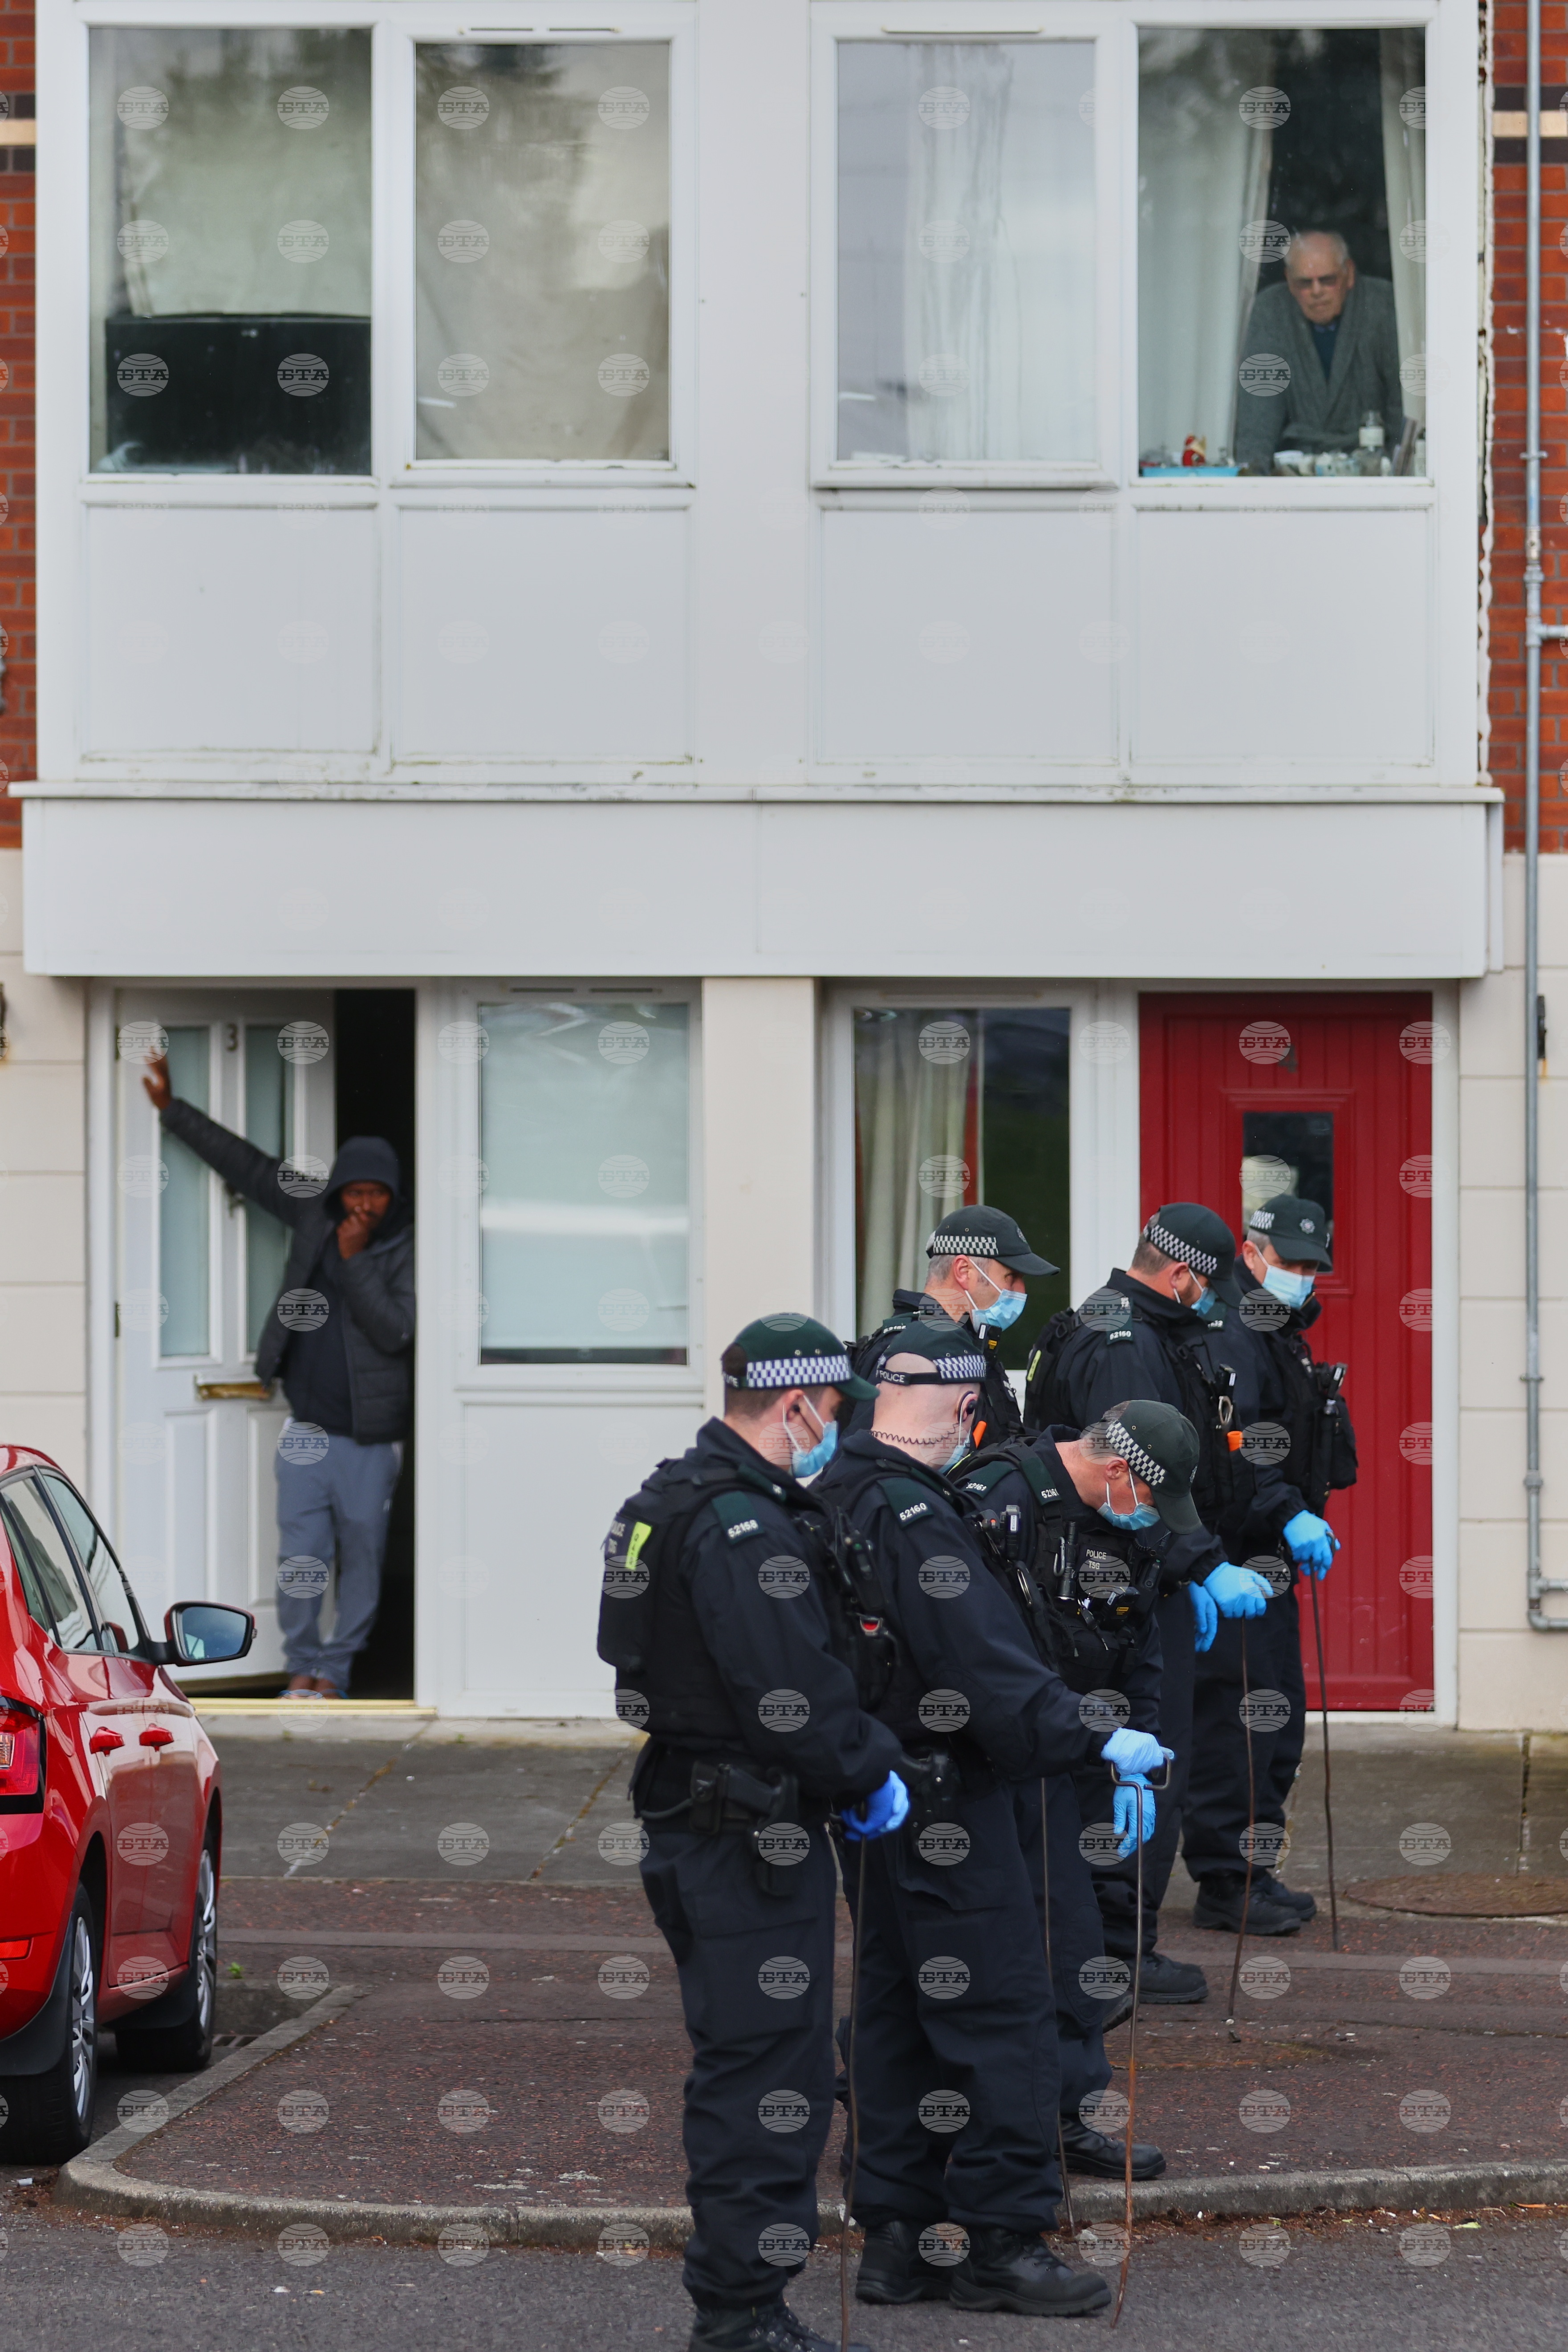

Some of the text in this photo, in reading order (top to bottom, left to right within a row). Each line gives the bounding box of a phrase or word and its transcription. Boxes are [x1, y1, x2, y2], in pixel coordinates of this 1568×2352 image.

[227, 1024, 238, 1051] 3
[1277, 1044, 1298, 1073] 4
[879, 1370, 905, 1383] POLICE
[1041, 1488, 1059, 1498] 52161
[900, 1503, 927, 1520] 52160
[727, 1519, 759, 1539] 52158
[1086, 1549, 1107, 1560] POLICE
[1089, 1561, 1100, 1569] TSG
